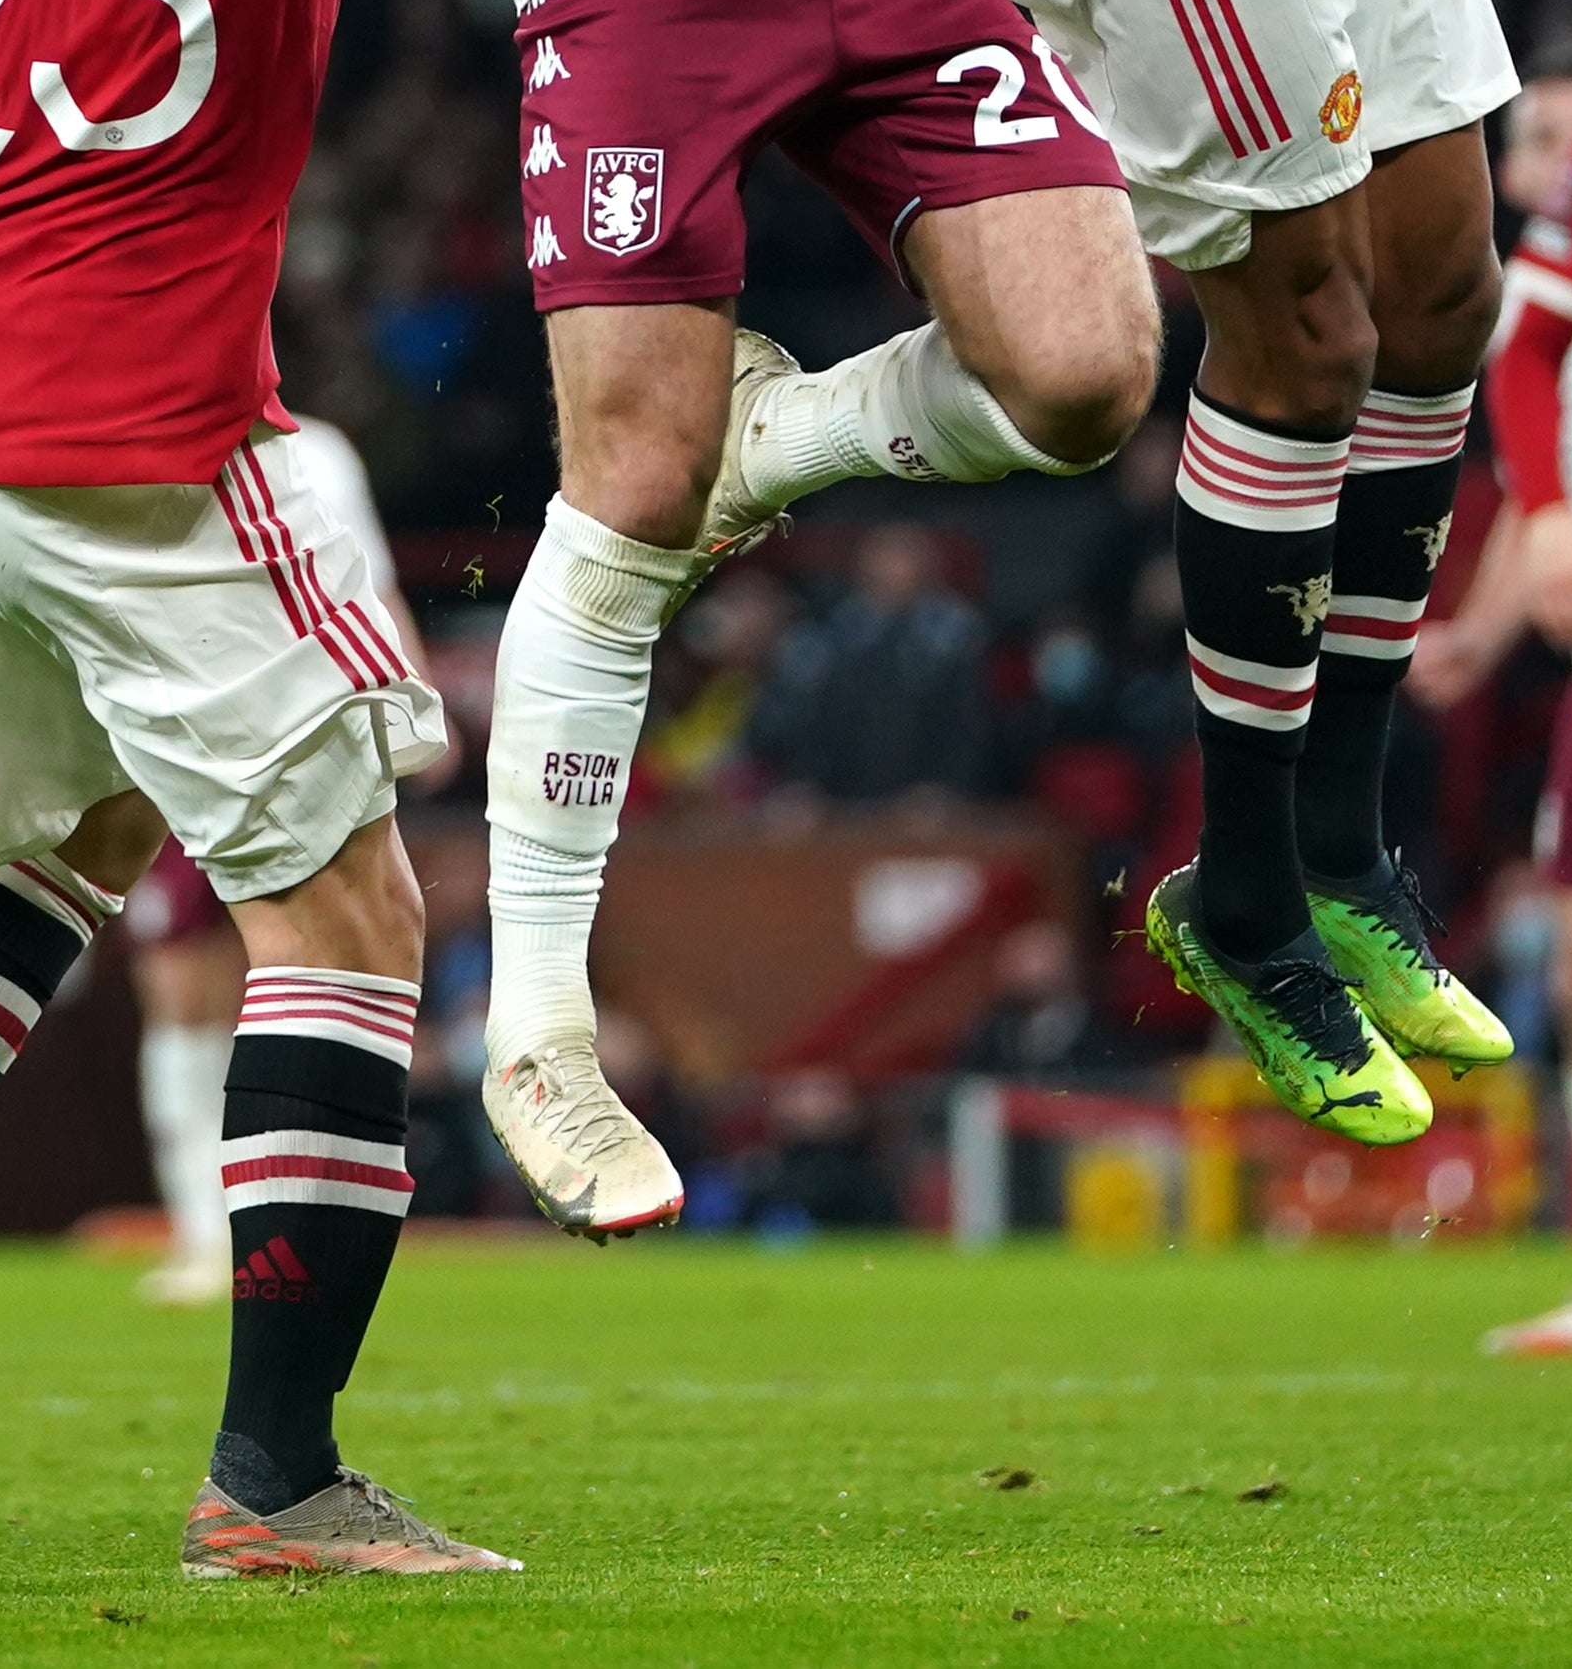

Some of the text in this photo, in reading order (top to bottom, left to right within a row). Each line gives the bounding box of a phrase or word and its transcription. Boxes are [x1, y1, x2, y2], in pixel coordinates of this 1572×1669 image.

[592, 153, 657, 173] AVFC
[544, 752, 620, 779] ASTON
[543, 776, 613, 807] VILLA
